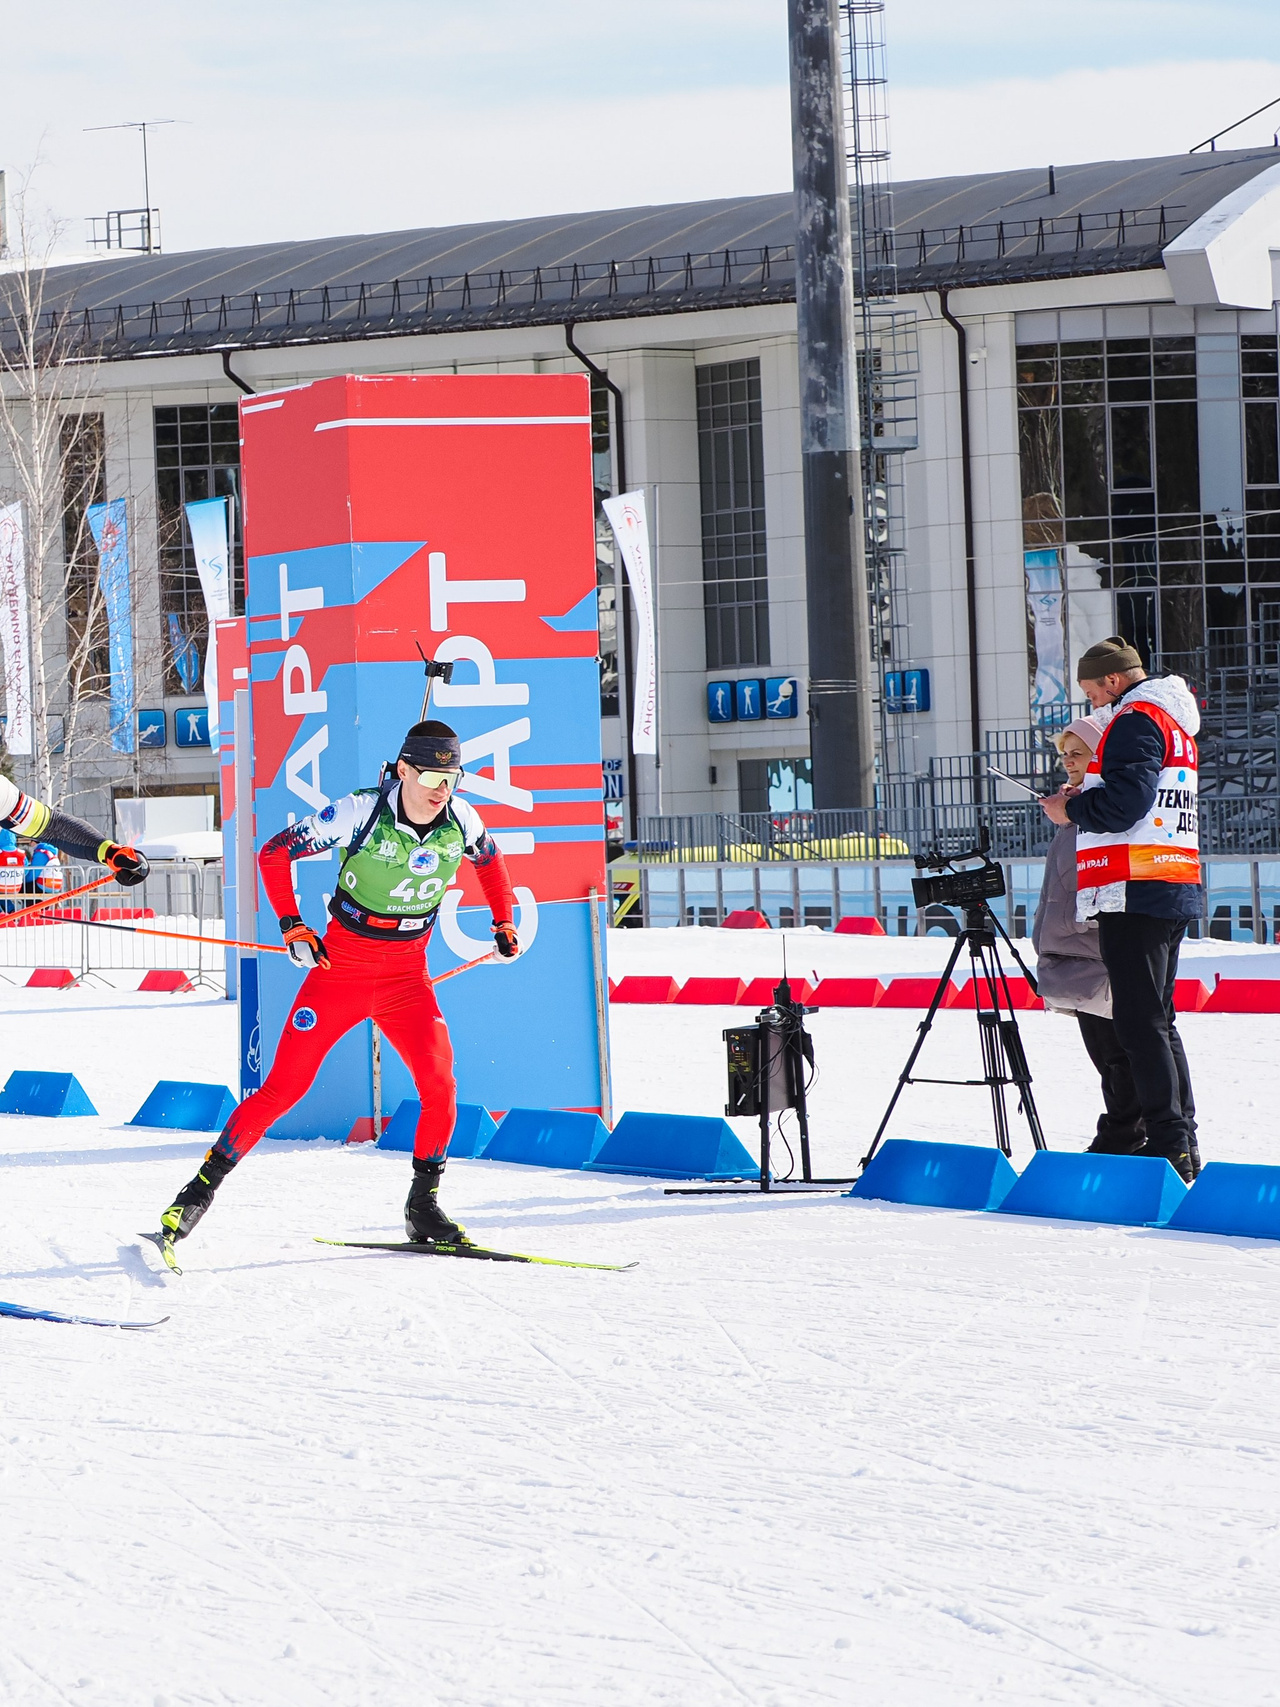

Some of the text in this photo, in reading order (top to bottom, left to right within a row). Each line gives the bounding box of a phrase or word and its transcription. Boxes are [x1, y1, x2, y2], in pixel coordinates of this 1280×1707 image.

[428, 552, 539, 966] САРТ
[0, 870, 24, 878] СУДЬ
[389, 877, 444, 903] 40
[386, 901, 433, 912] КРАСНОЯРСК
